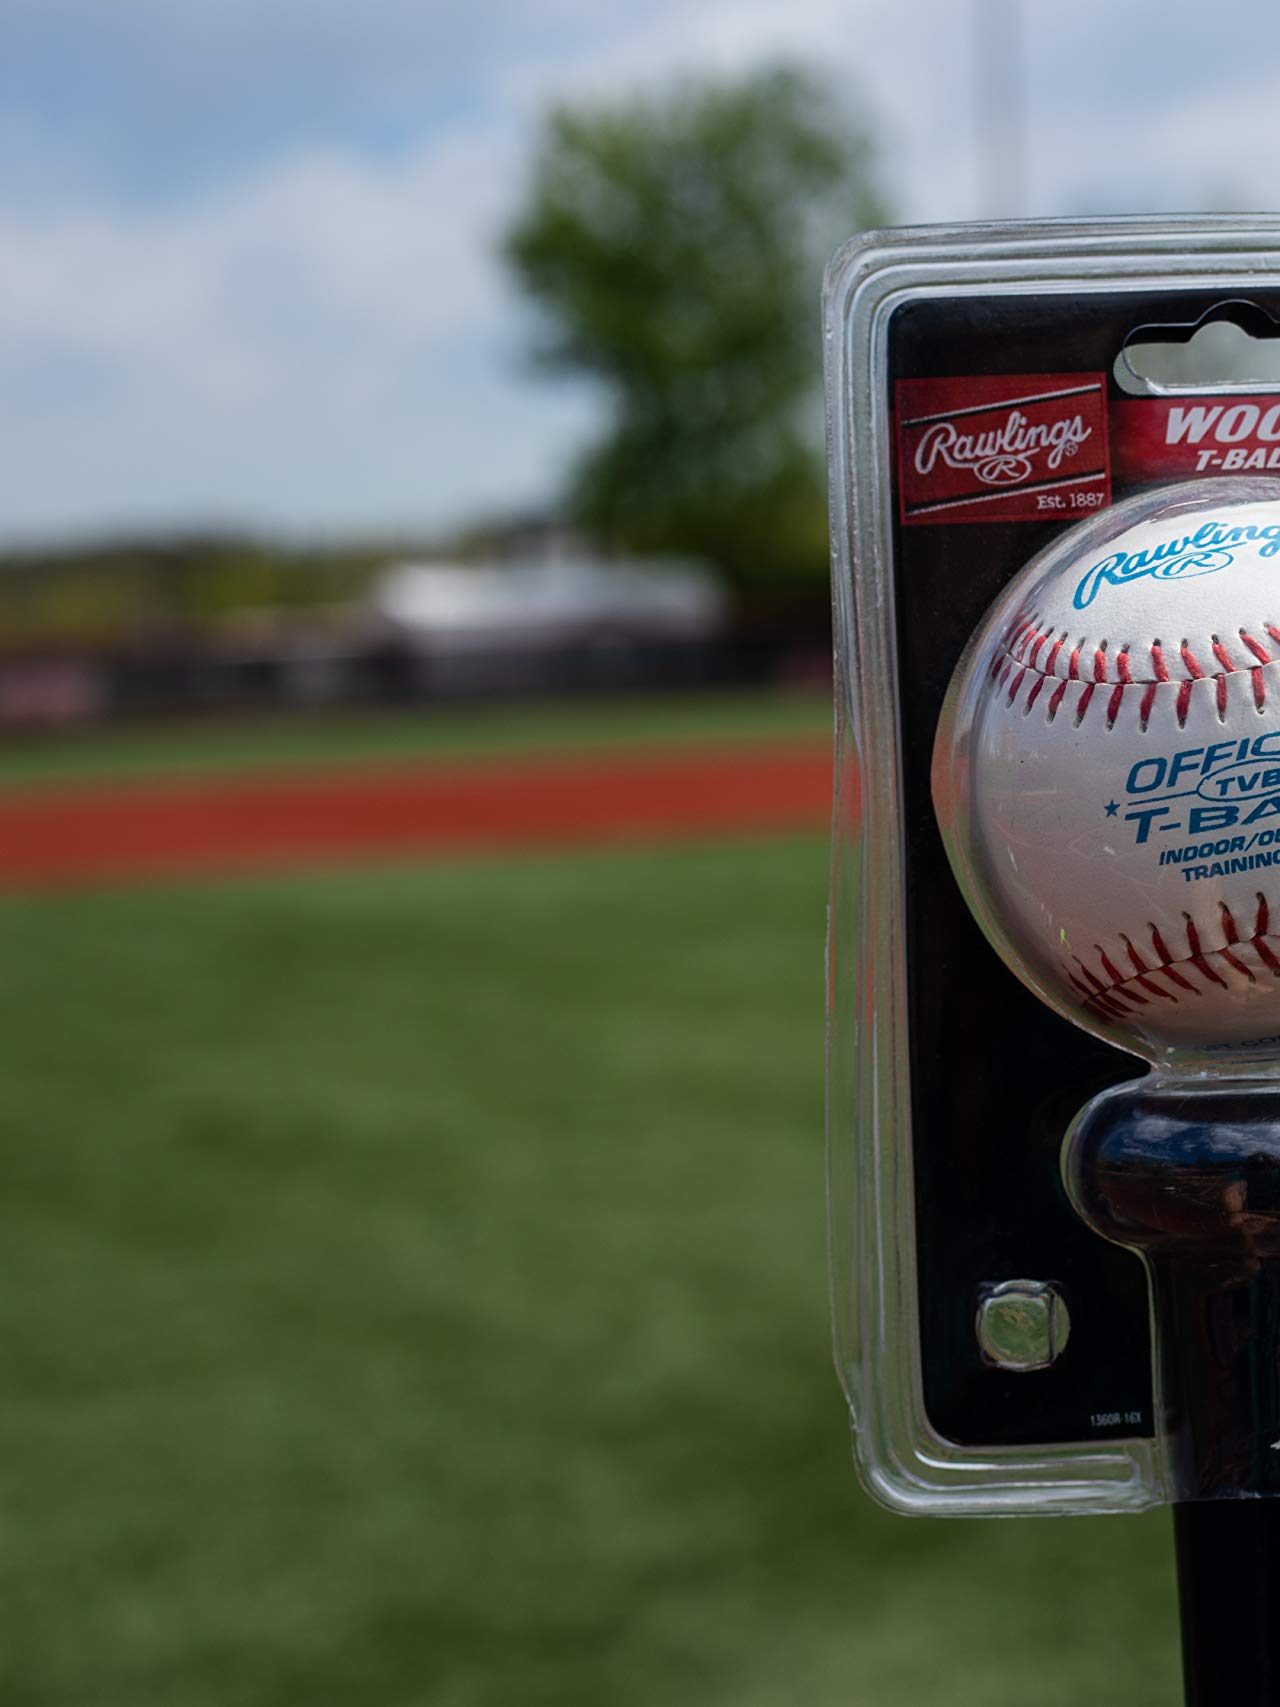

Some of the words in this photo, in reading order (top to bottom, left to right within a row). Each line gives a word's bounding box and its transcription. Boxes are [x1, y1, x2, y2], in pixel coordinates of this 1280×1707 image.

[914, 410, 1093, 475] Rawlings
[1036, 494, 1067, 511] Est.
[1070, 491, 1105, 508] 1887
